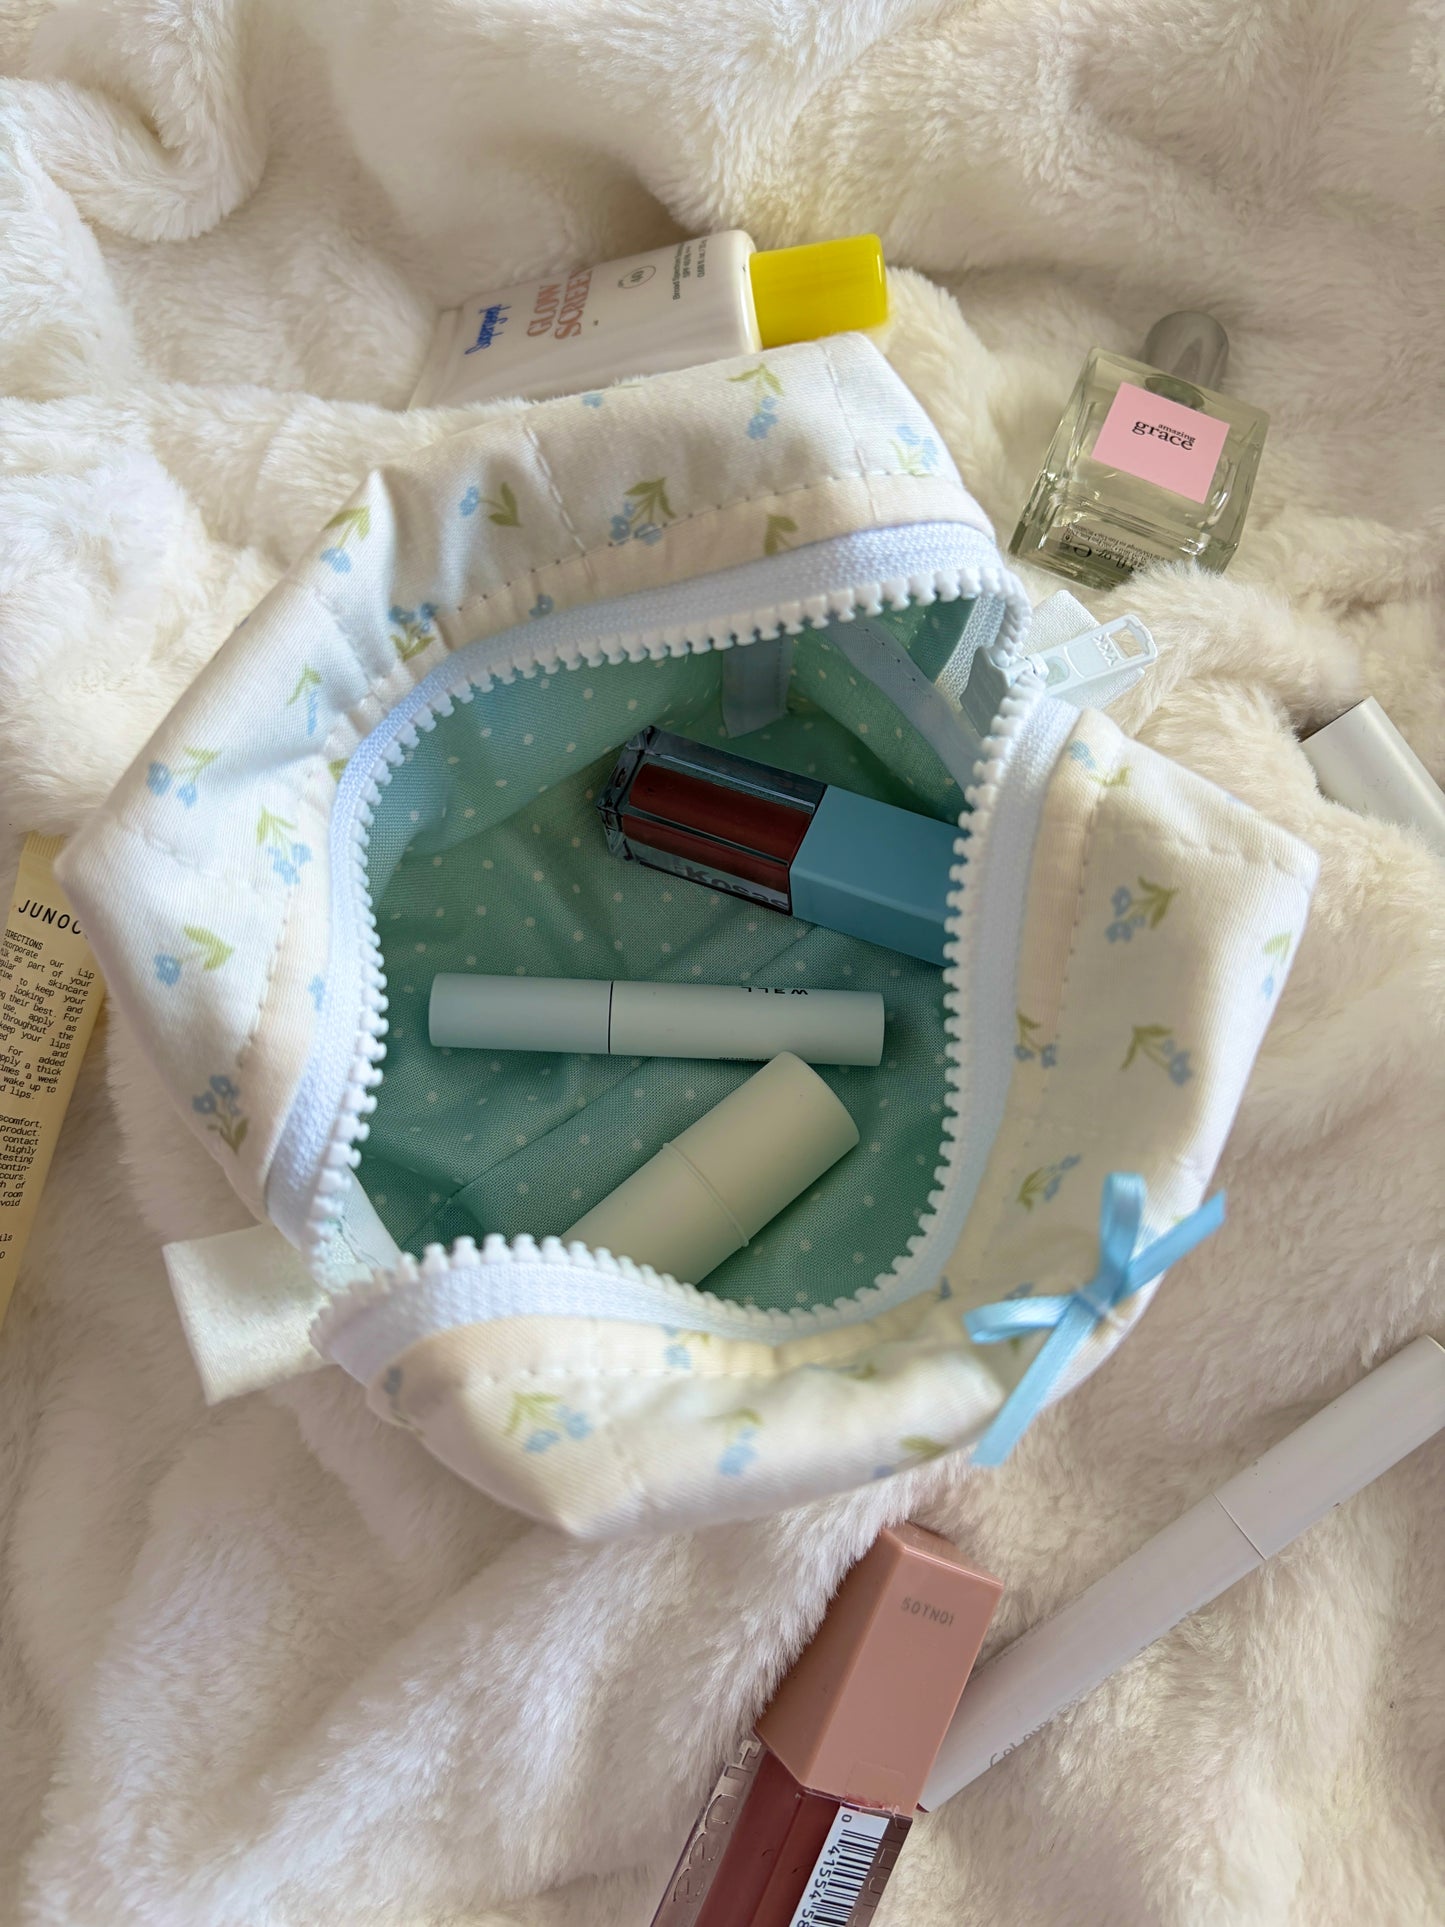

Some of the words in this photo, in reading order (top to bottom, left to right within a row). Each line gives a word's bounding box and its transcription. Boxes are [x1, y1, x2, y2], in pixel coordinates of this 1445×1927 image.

[1132, 421, 1193, 451] grace
[1158, 423, 1196, 444] amazing
[18, 899, 83, 935] JUNOC
[14, 955, 23, 963] as
[27, 960, 46, 973] part
[51, 970, 64, 979] of
[70, 976, 92, 988] your
[49, 959, 65, 969] our
[78, 967, 95, 980] Lip
[19, 977, 28, 986] to
[35, 982, 55, 997] keep
[63, 994, 86, 1006] your
[48, 978, 89, 997] skincare
[9, 994, 31, 1008] their
[33, 1003, 57, 1019] best.
[63, 1012, 80, 1024] For
[14, 984, 45, 1005] looking
[66, 1005, 84, 1015] and
[2, 1012, 47, 1035] throughout
[58, 1031, 74, 1041] the
[28, 1013, 55, 1028] apply
[65, 1023, 78, 1032] as
[20, 1030, 43, 1043] your
[49, 1037, 71, 1050] lips
[7, 1045, 24, 1057] For
[38, 1055, 66, 1067] added
[51, 1050, 69, 1059] and
[24, 1062, 31, 1070] a
[36, 1065, 63, 1076] thick
[25, 1072, 32, 1080] a
[38, 1074, 60, 1085] week
[3, 1074, 25, 1088] wake
[29, 1083, 41, 1092] up
[46, 1084, 57, 1094] to
[9, 1086, 35, 1100] lips.
[0, 1125, 41, 1138] product.
[2, 1134, 39, 1146] contact
[5, 1143, 37, 1156] highly
[2, 1190, 24, 1199] room
[15, 1180, 27, 1190] of
[841, 1813, 853, 1824] 0
[808, 1845, 841, 1901] 41554
